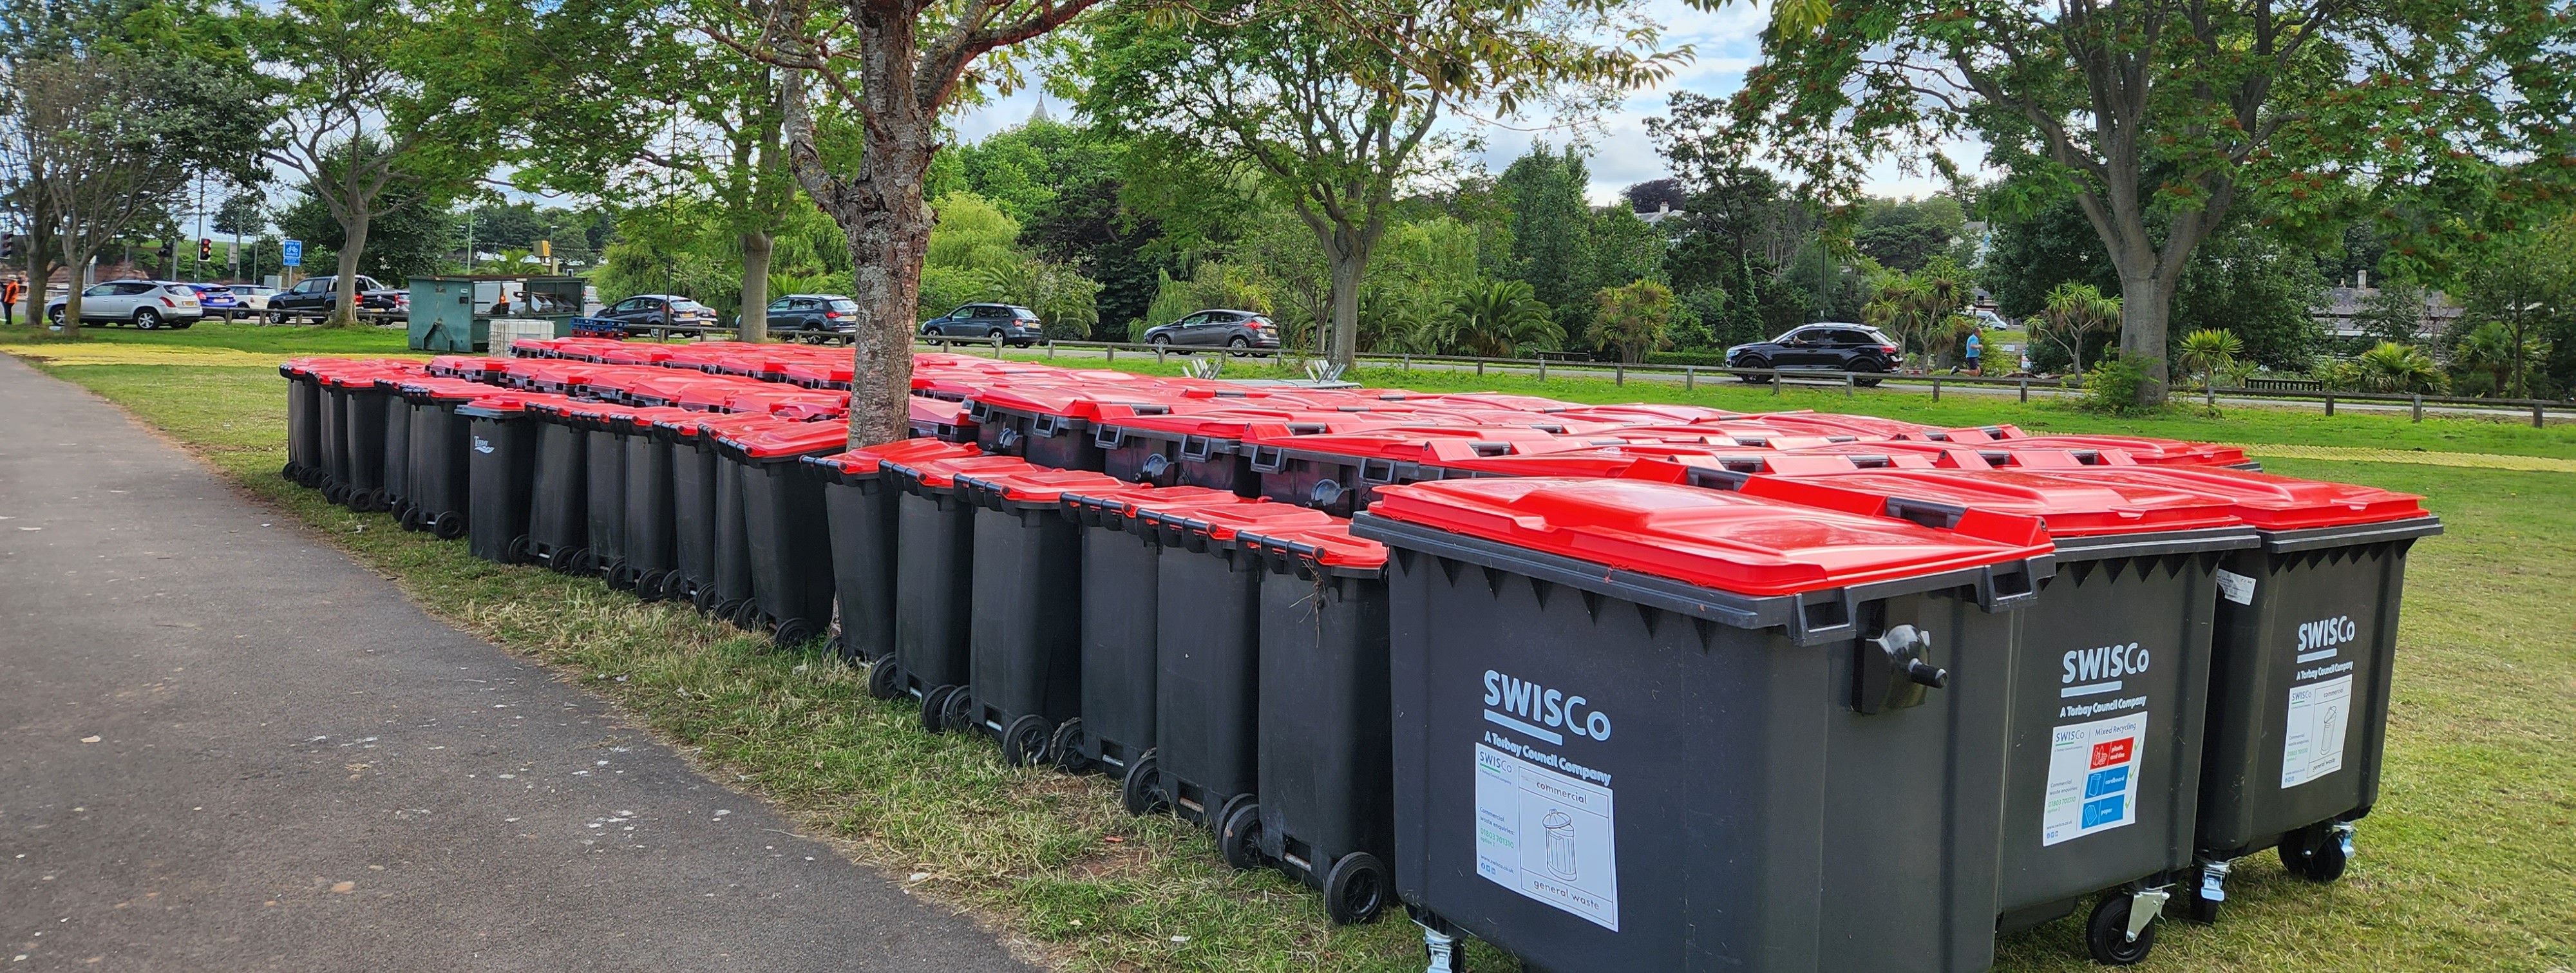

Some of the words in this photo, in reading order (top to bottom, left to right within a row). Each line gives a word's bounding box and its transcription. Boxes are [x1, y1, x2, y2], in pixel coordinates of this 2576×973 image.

[2297, 615, 2355, 652] SWISCo
[2062, 642, 2150, 684] SWISCo
[2297, 672, 2301, 681] A
[2301, 669, 2318, 679] Torbay
[2318, 664, 2334, 675] Council
[2335, 661, 2353, 672] Company
[2324, 686, 2344, 697] commercial
[1484, 670, 1611, 741] SWISCo
[2060, 706, 2066, 718] A
[2067, 704, 2092, 717] Torbay
[2092, 699, 2117, 713] Council
[2118, 695, 2146, 709] Company
[2056, 730, 2085, 742] SWISCo
[2095, 726, 2112, 737] Mixed
[2113, 723, 2137, 733] Recycling
[1484, 730, 1492, 743] A
[1492, 732, 1522, 757] Torbay
[1522, 745, 1558, 768] Council
[1558, 757, 1611, 786] Company
[2112, 744, 2123, 753] plastic
[1480, 751, 1512, 773] SWISCo
[2050, 779, 2072, 788] Commercial
[2105, 775, 2125, 785] cardboard
[1537, 781, 1587, 804] commercial
[2048, 799, 2061, 808] 01803
[2101, 808, 2112, 817] paper
[1480, 806, 1504, 822] Commercial
[1480, 816, 1492, 826] waste
[1493, 823, 1515, 836] enquiries:
[1481, 827, 1495, 840] 01803
[1496, 835, 1514, 849] 701310
[1481, 855, 1514, 874] www.swisco.co.uk
[1533, 880, 1569, 898] general
[1571, 893, 1600, 910] waste
